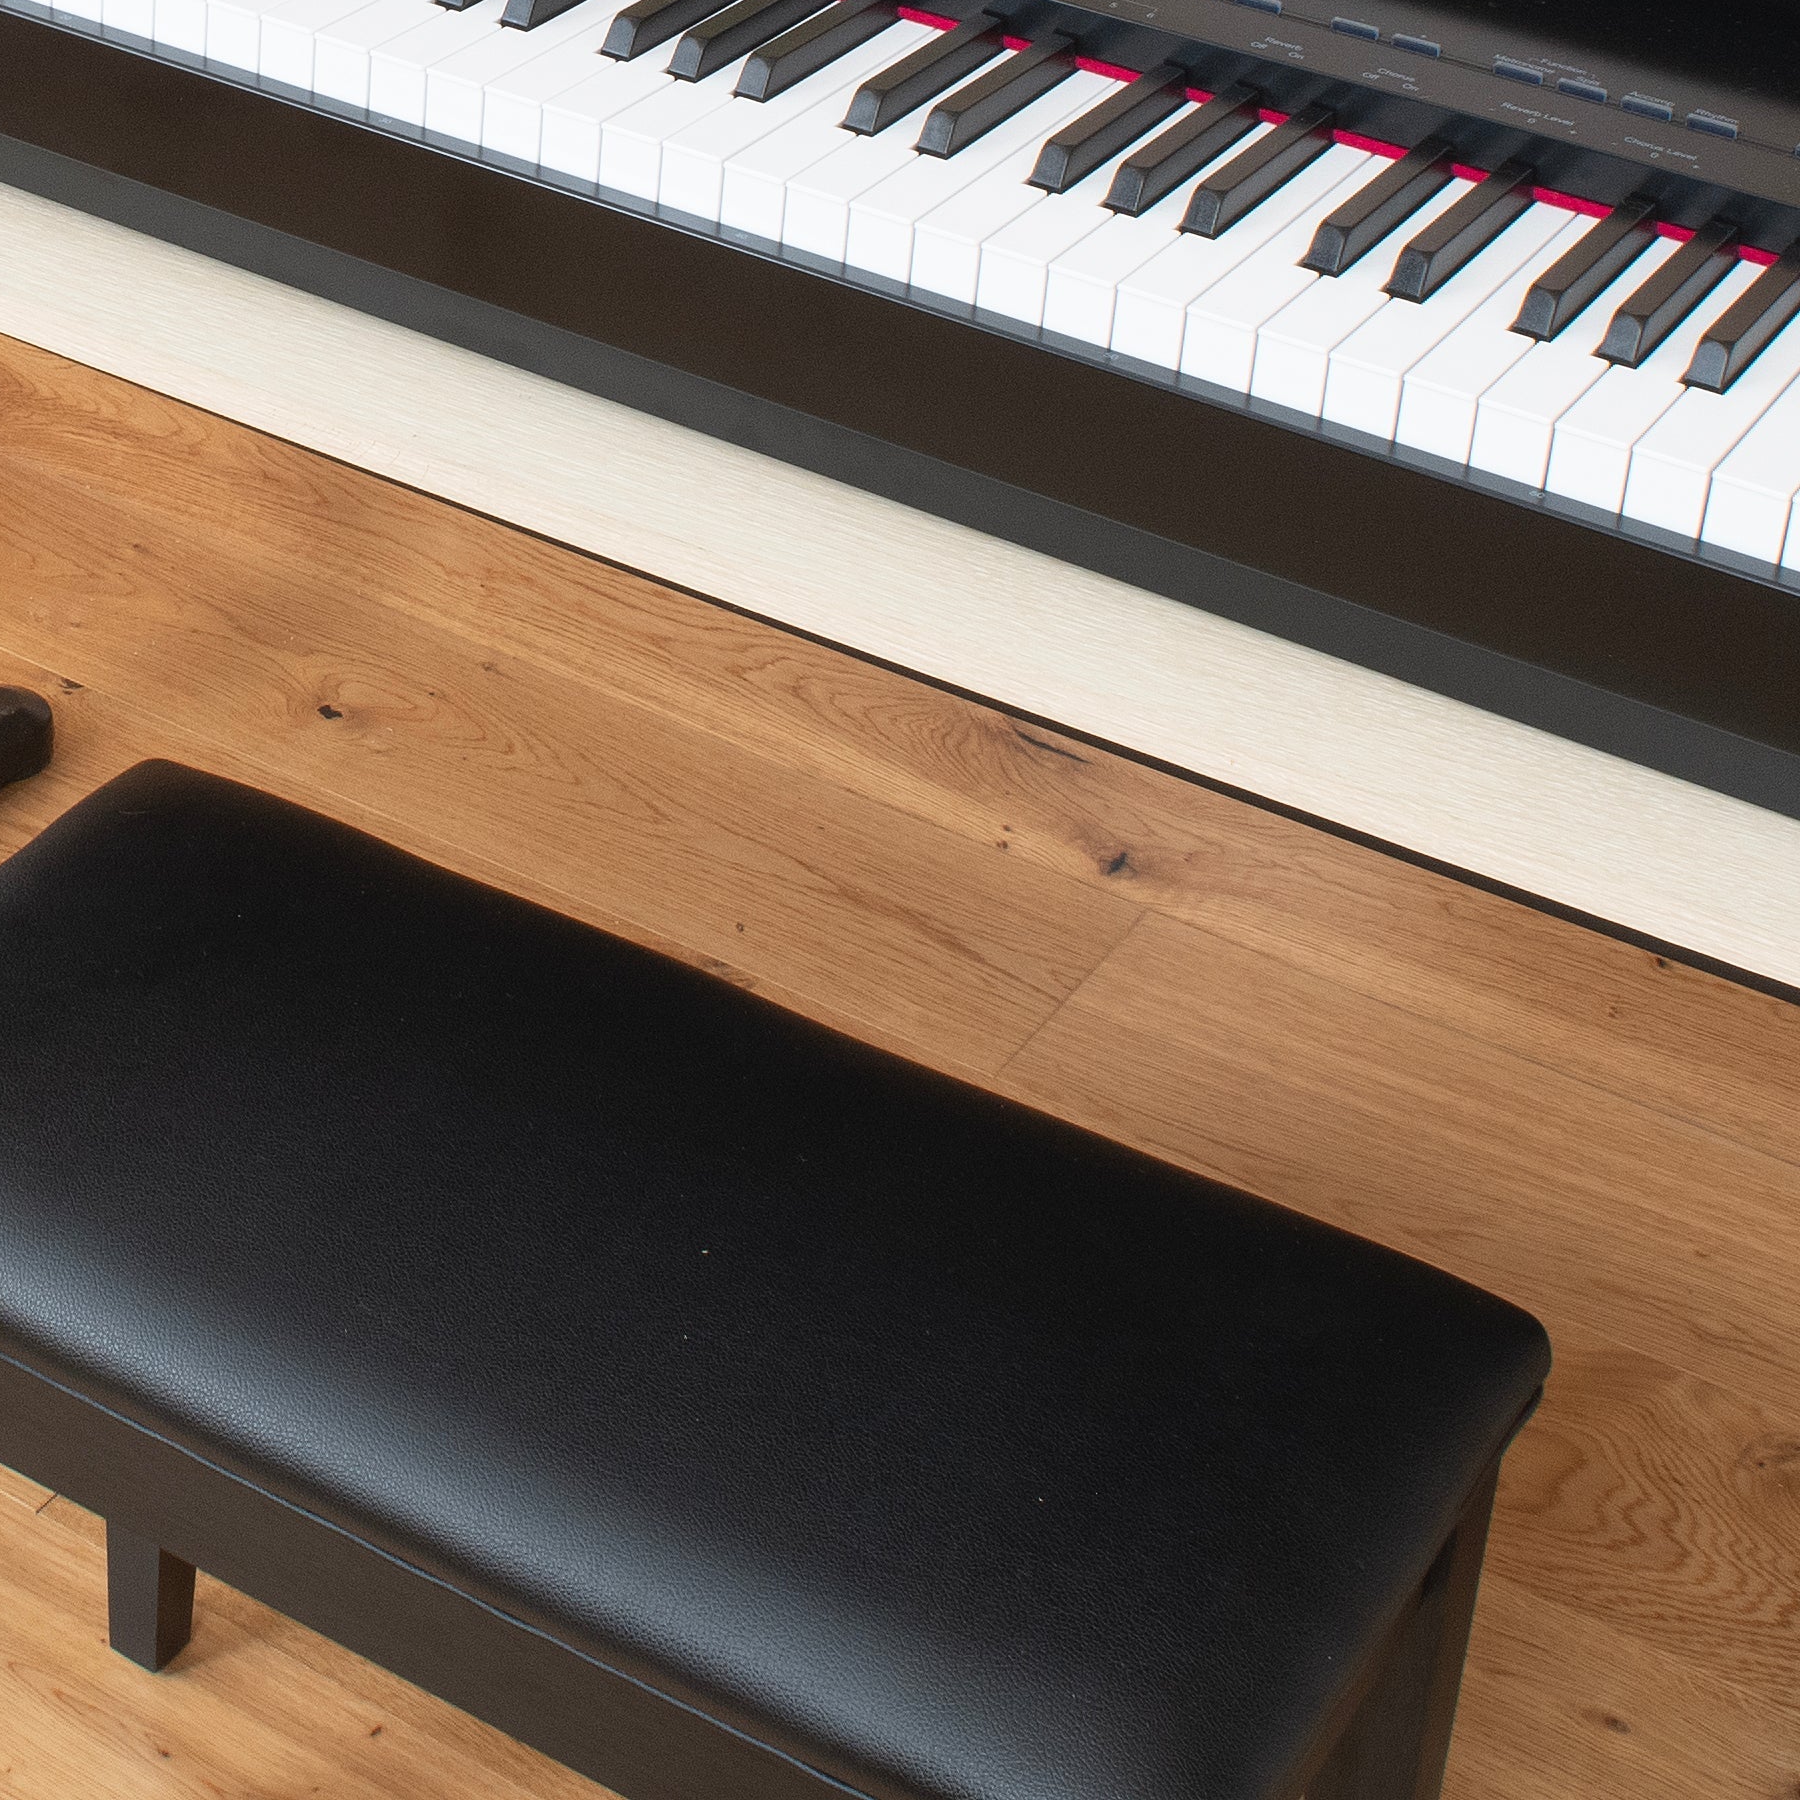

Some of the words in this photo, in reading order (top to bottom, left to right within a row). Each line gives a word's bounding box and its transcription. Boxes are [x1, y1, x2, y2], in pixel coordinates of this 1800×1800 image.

[1288, 51, 1304, 60] On
[1376, 67, 1415, 83] Chorus
[1402, 82, 1419, 92] On
[1500, 101, 1542, 118] Reverb
[1544, 113, 1574, 128] Level
[1623, 135, 1664, 152] Chorus
[1666, 146, 1697, 161] Level
